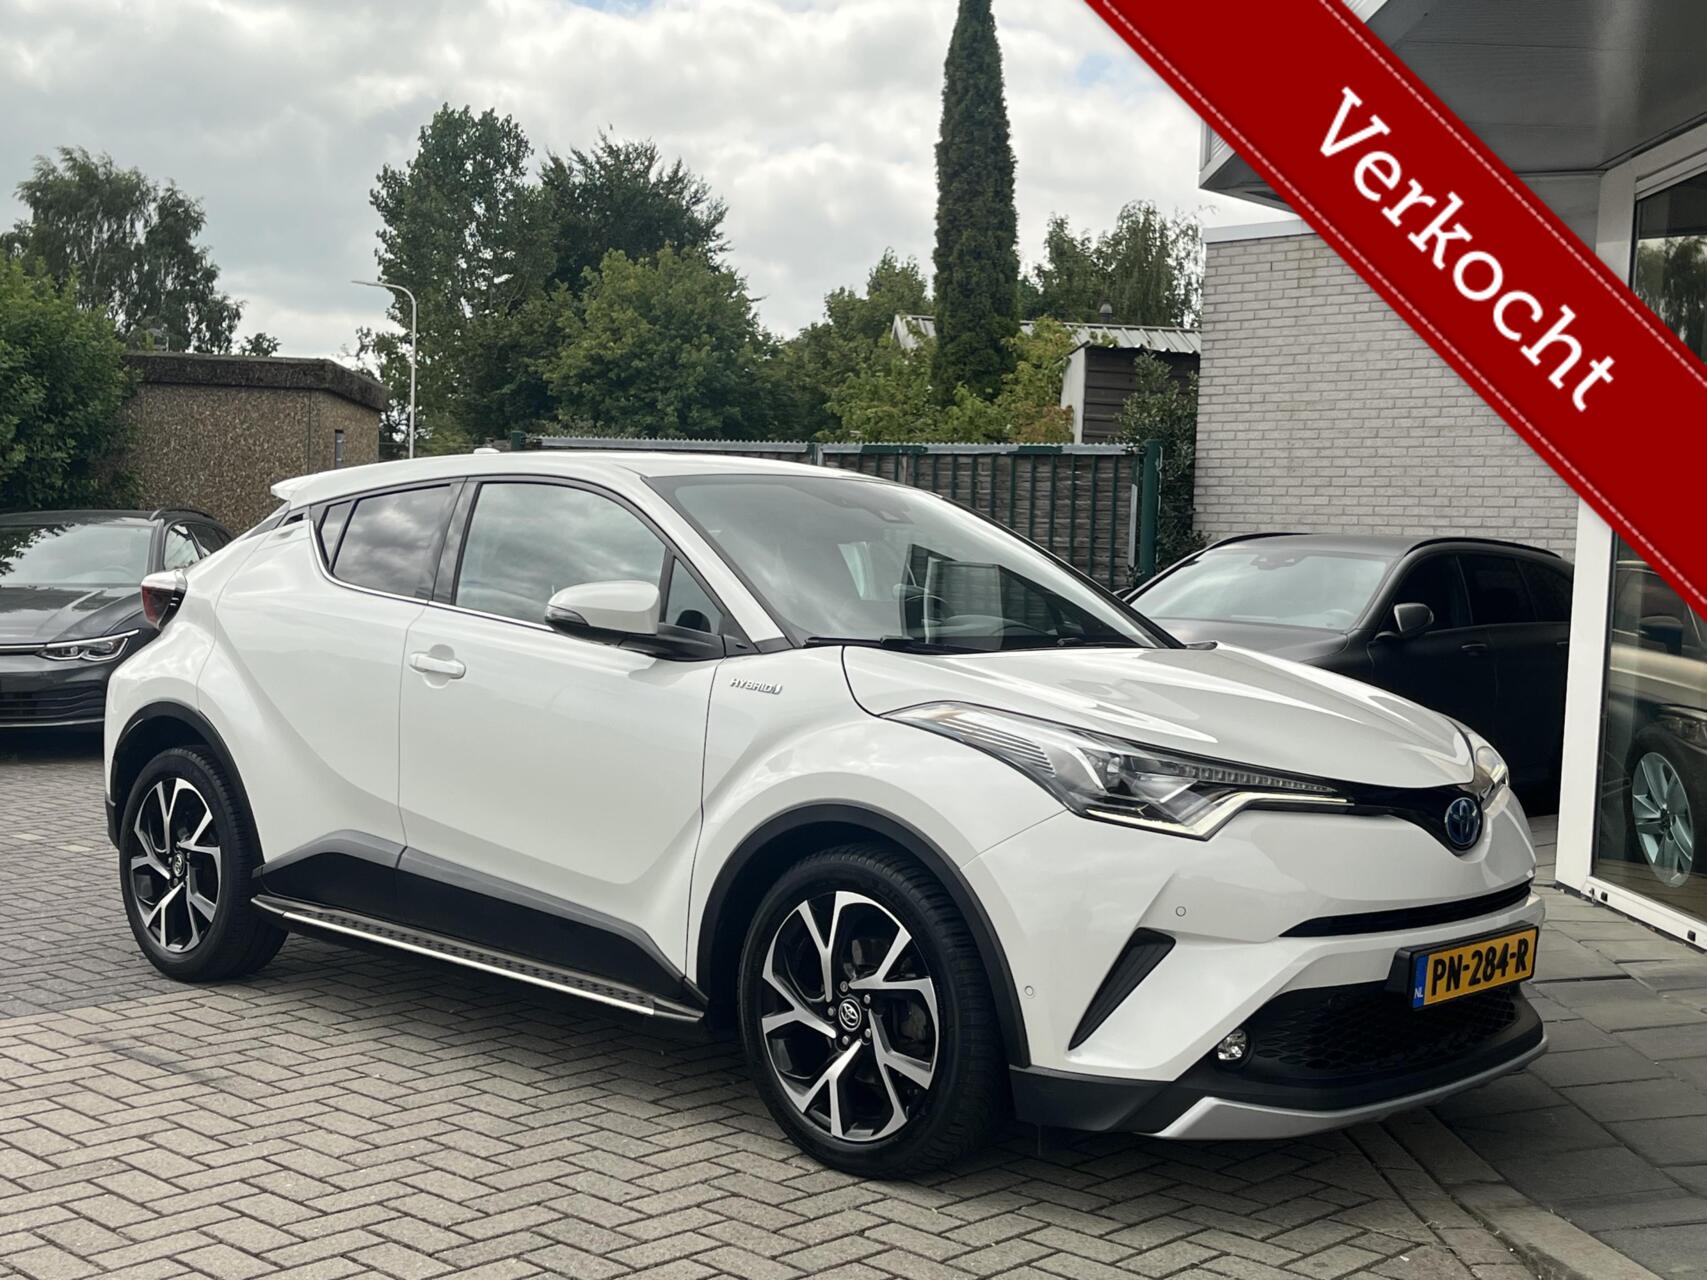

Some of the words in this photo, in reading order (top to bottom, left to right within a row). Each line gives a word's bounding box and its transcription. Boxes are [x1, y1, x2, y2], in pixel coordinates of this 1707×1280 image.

[730, 678, 773, 694] HYBRID
[1431, 938, 1529, 996] PN-284-R
[1414, 986, 1424, 998] NL
